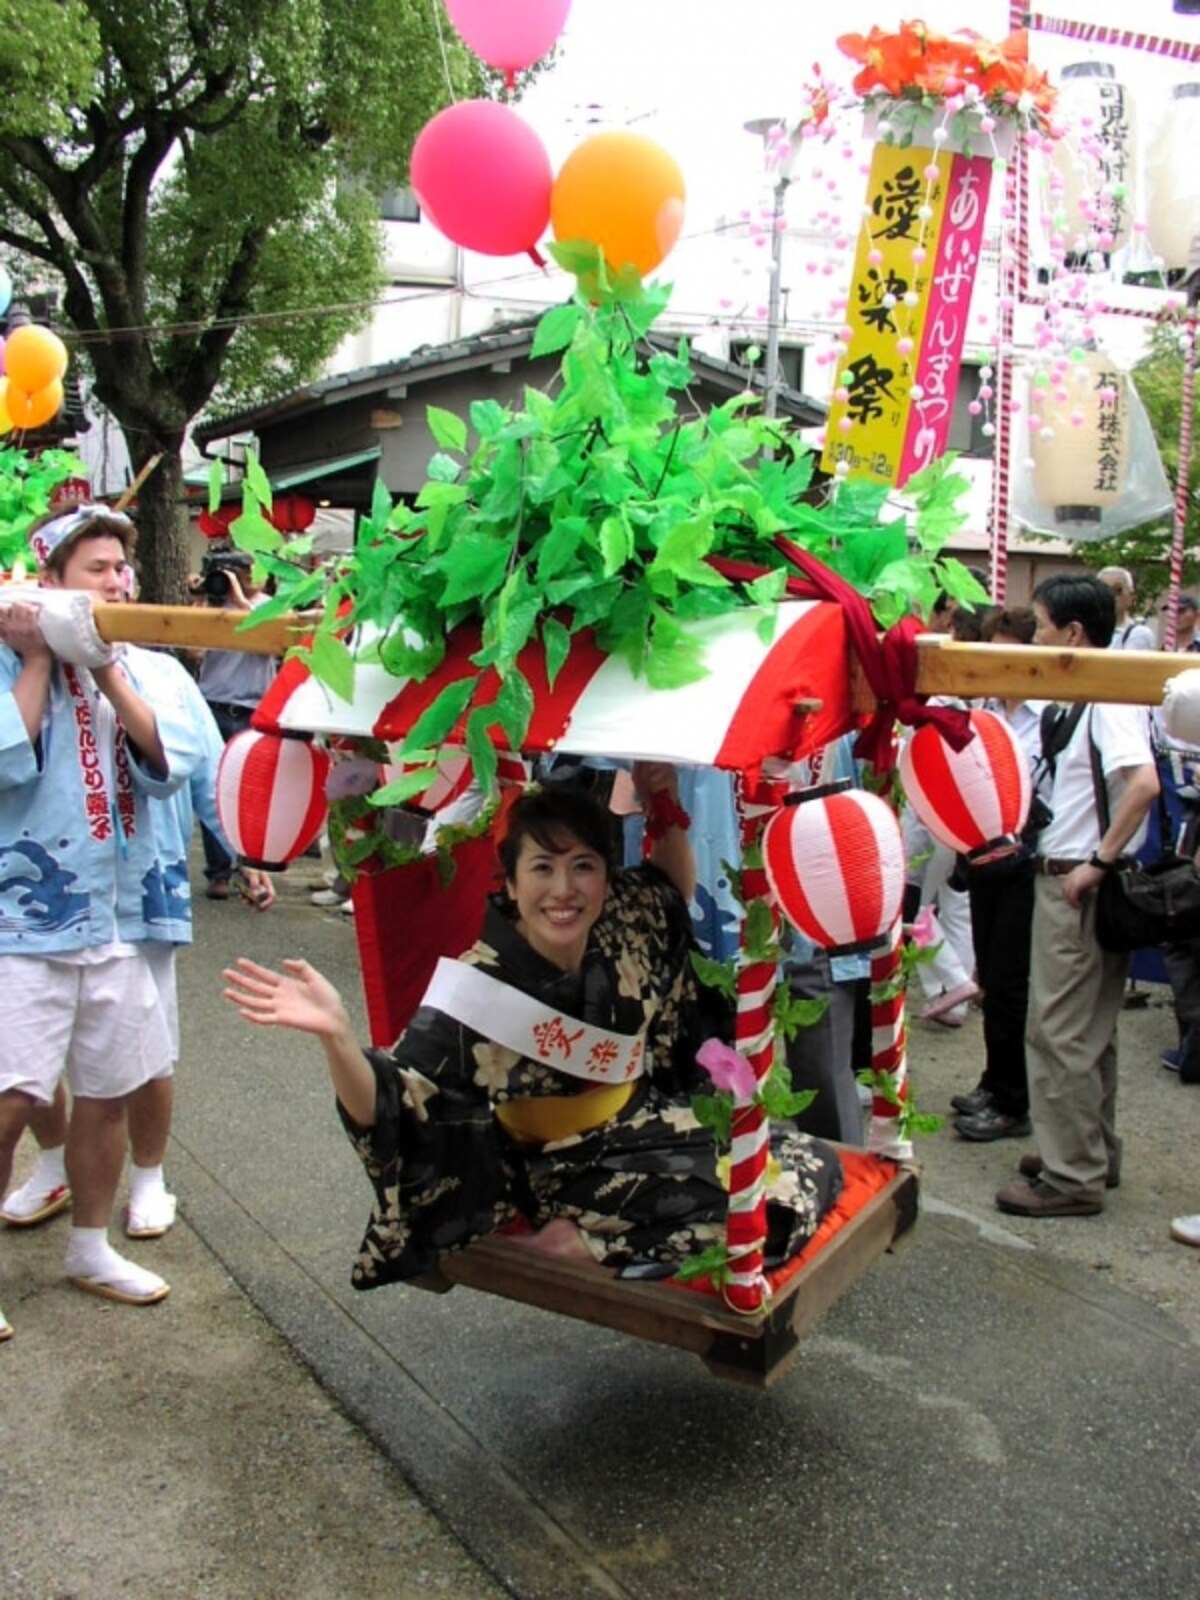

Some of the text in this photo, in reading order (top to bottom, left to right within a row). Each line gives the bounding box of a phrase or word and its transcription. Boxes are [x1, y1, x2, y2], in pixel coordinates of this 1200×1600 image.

[846, 165, 926, 425] 愛染祭
[910, 167, 980, 476] あいぜんまつり
